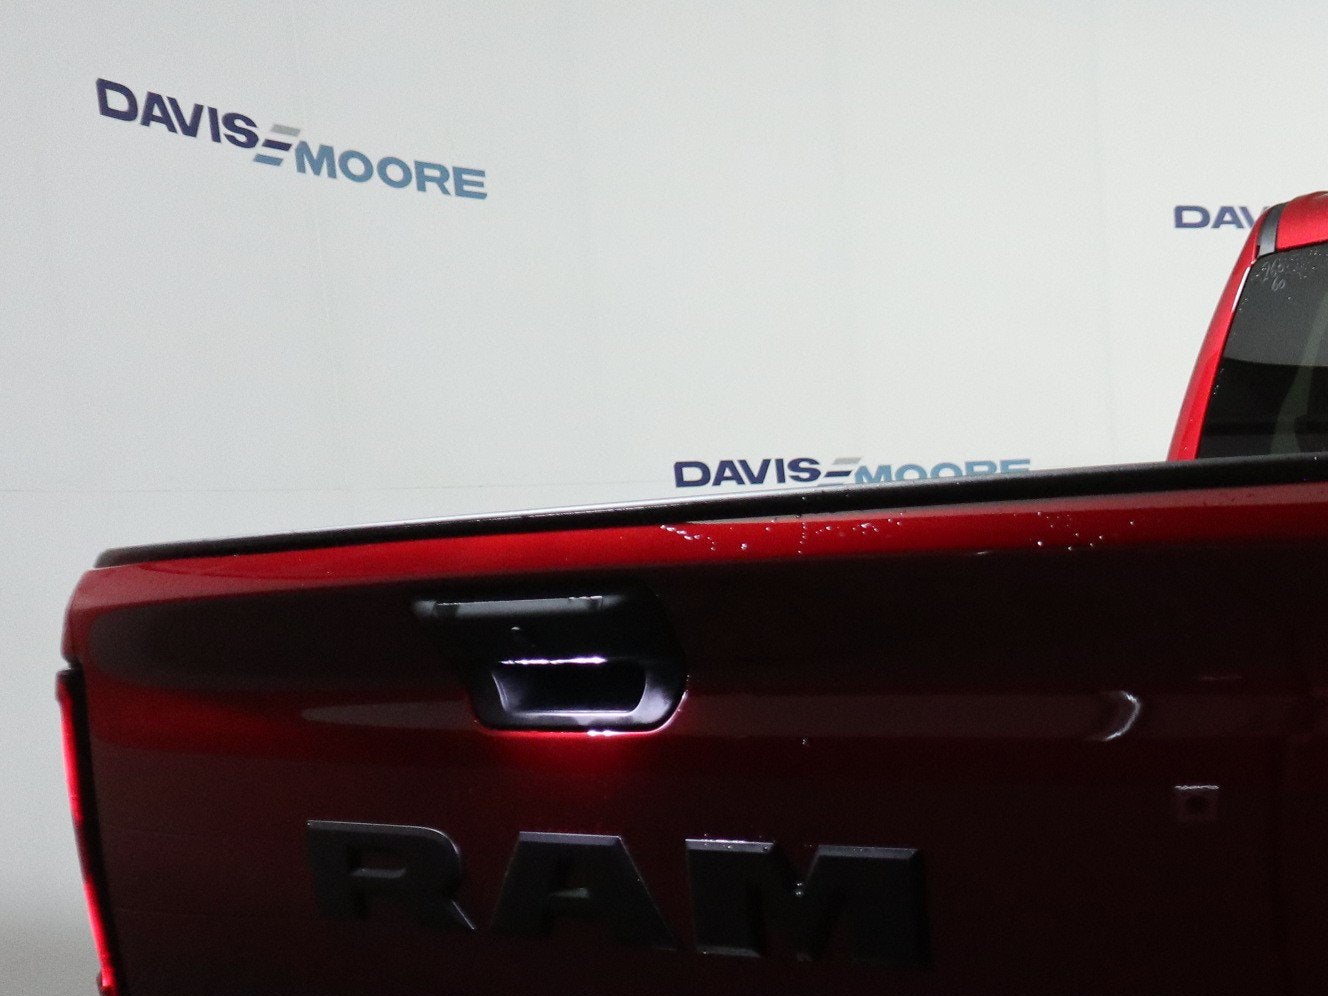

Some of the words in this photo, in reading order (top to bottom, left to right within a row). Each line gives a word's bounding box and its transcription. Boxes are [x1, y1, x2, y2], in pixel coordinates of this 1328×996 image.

[95, 77, 260, 149] DAVIS
[295, 140, 488, 200] MOORE
[1173, 205, 1267, 229] DAV
[673, 457, 822, 488] DAVIS
[305, 819, 932, 968] RAM
